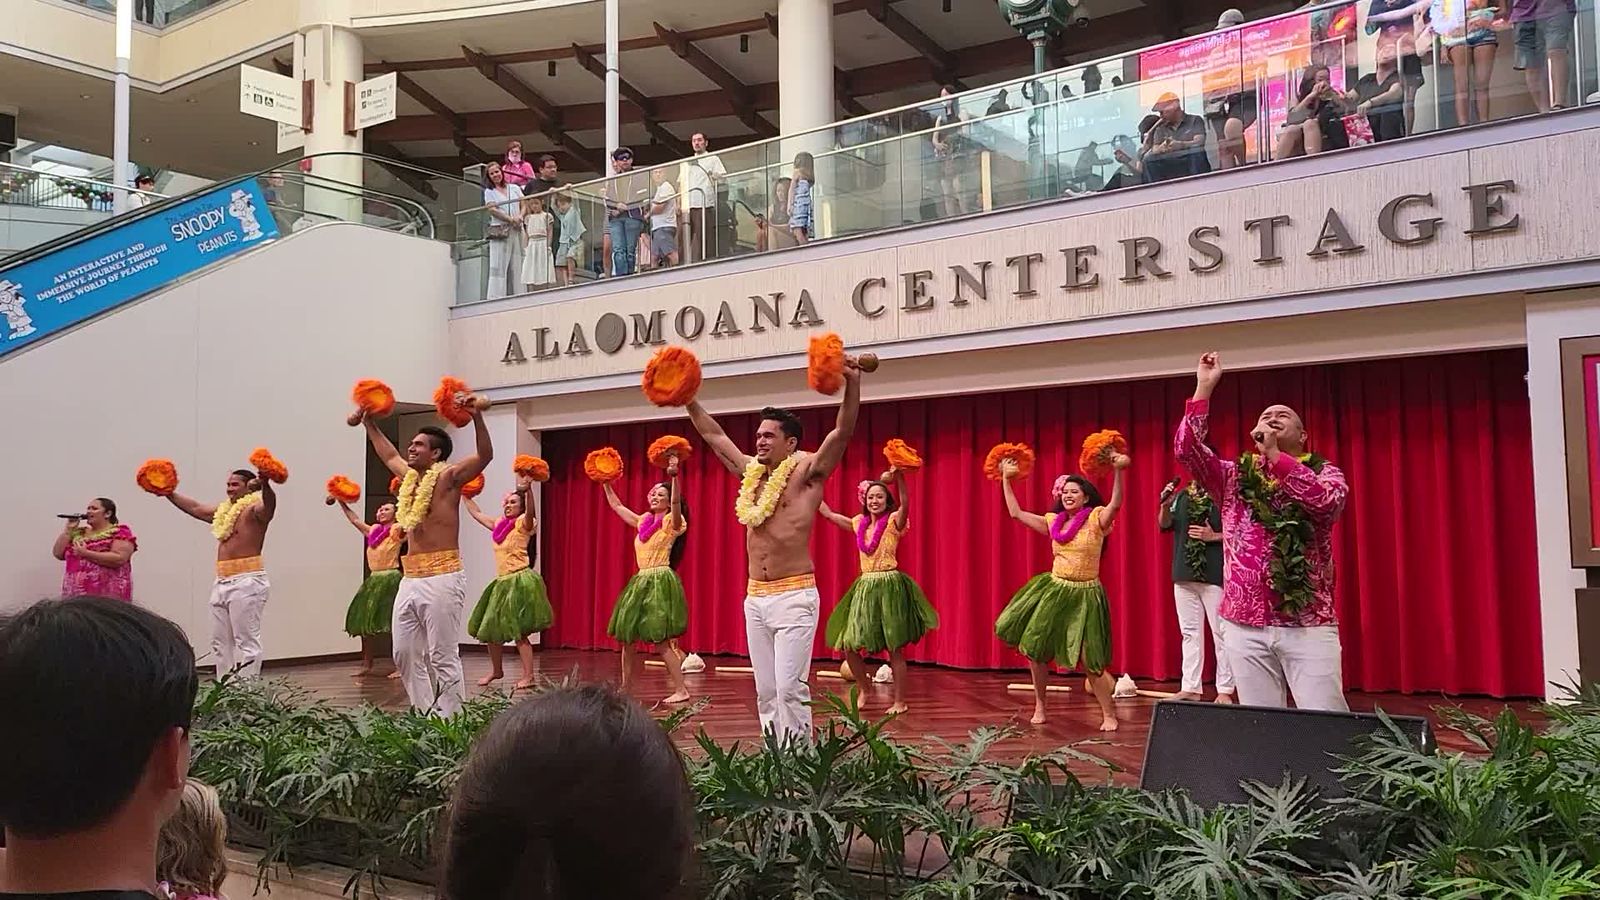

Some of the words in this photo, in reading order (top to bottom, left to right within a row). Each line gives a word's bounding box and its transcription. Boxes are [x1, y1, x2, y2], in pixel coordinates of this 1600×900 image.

[171, 206, 225, 242] SNOOPY
[197, 230, 238, 254] PEANUTS
[36, 276, 88, 301] IMMERSIVE
[87, 260, 127, 281] JOURNEY
[127, 243, 168, 265] THROUGH
[53, 274, 67, 284] AN
[67, 251, 126, 278] INTERACTIVE
[126, 243, 145, 255] AND
[56, 291, 76, 304] THE
[75, 278, 107, 295] WORLD
[108, 272, 120, 283] OF
[120, 257, 159, 278] PEANUTS
[500, 322, 593, 364] ALA
[628, 288, 826, 348] MOANA
[851, 179, 1521, 318] CENTERSTAGE
